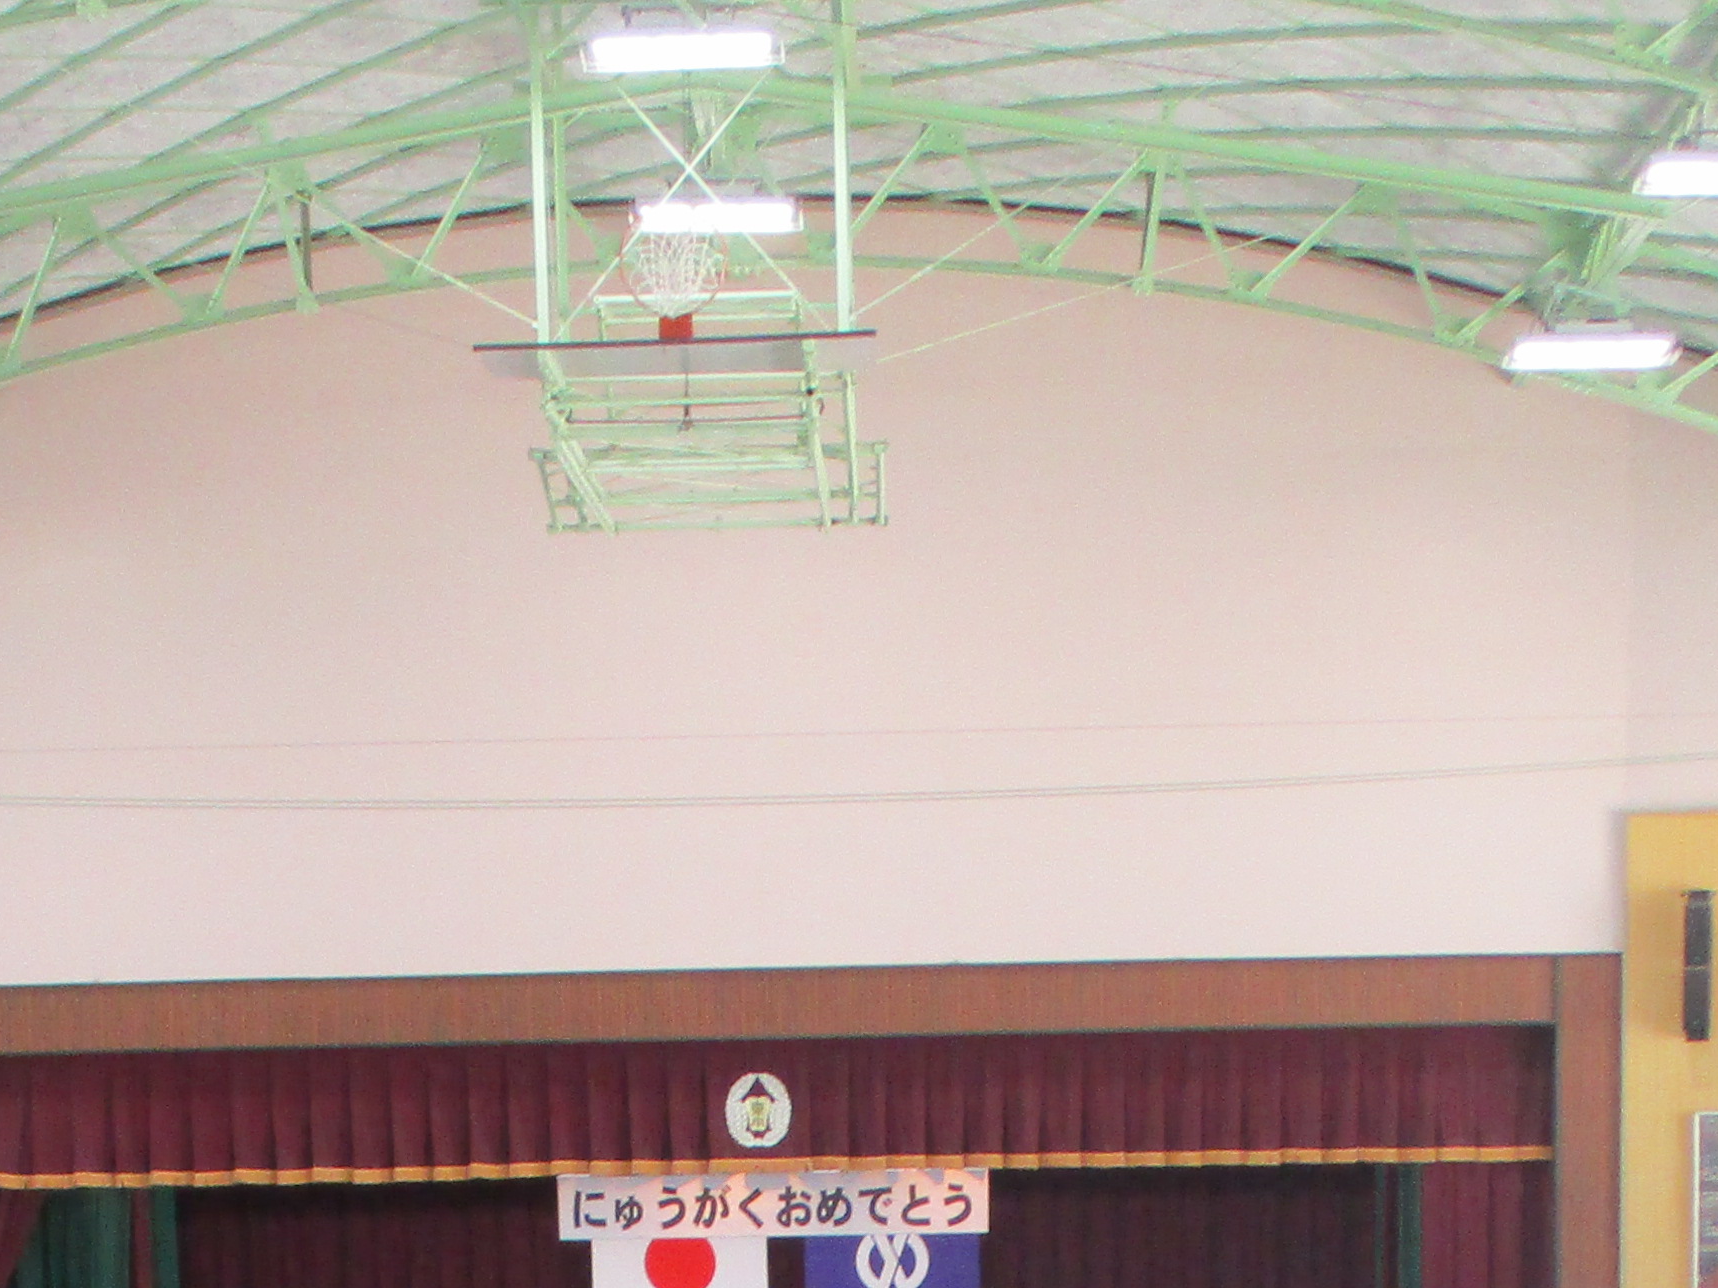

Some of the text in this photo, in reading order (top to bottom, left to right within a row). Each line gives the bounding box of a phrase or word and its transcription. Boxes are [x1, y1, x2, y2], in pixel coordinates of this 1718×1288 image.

[572, 1184, 973, 1229] にゅうがくおめでとう
